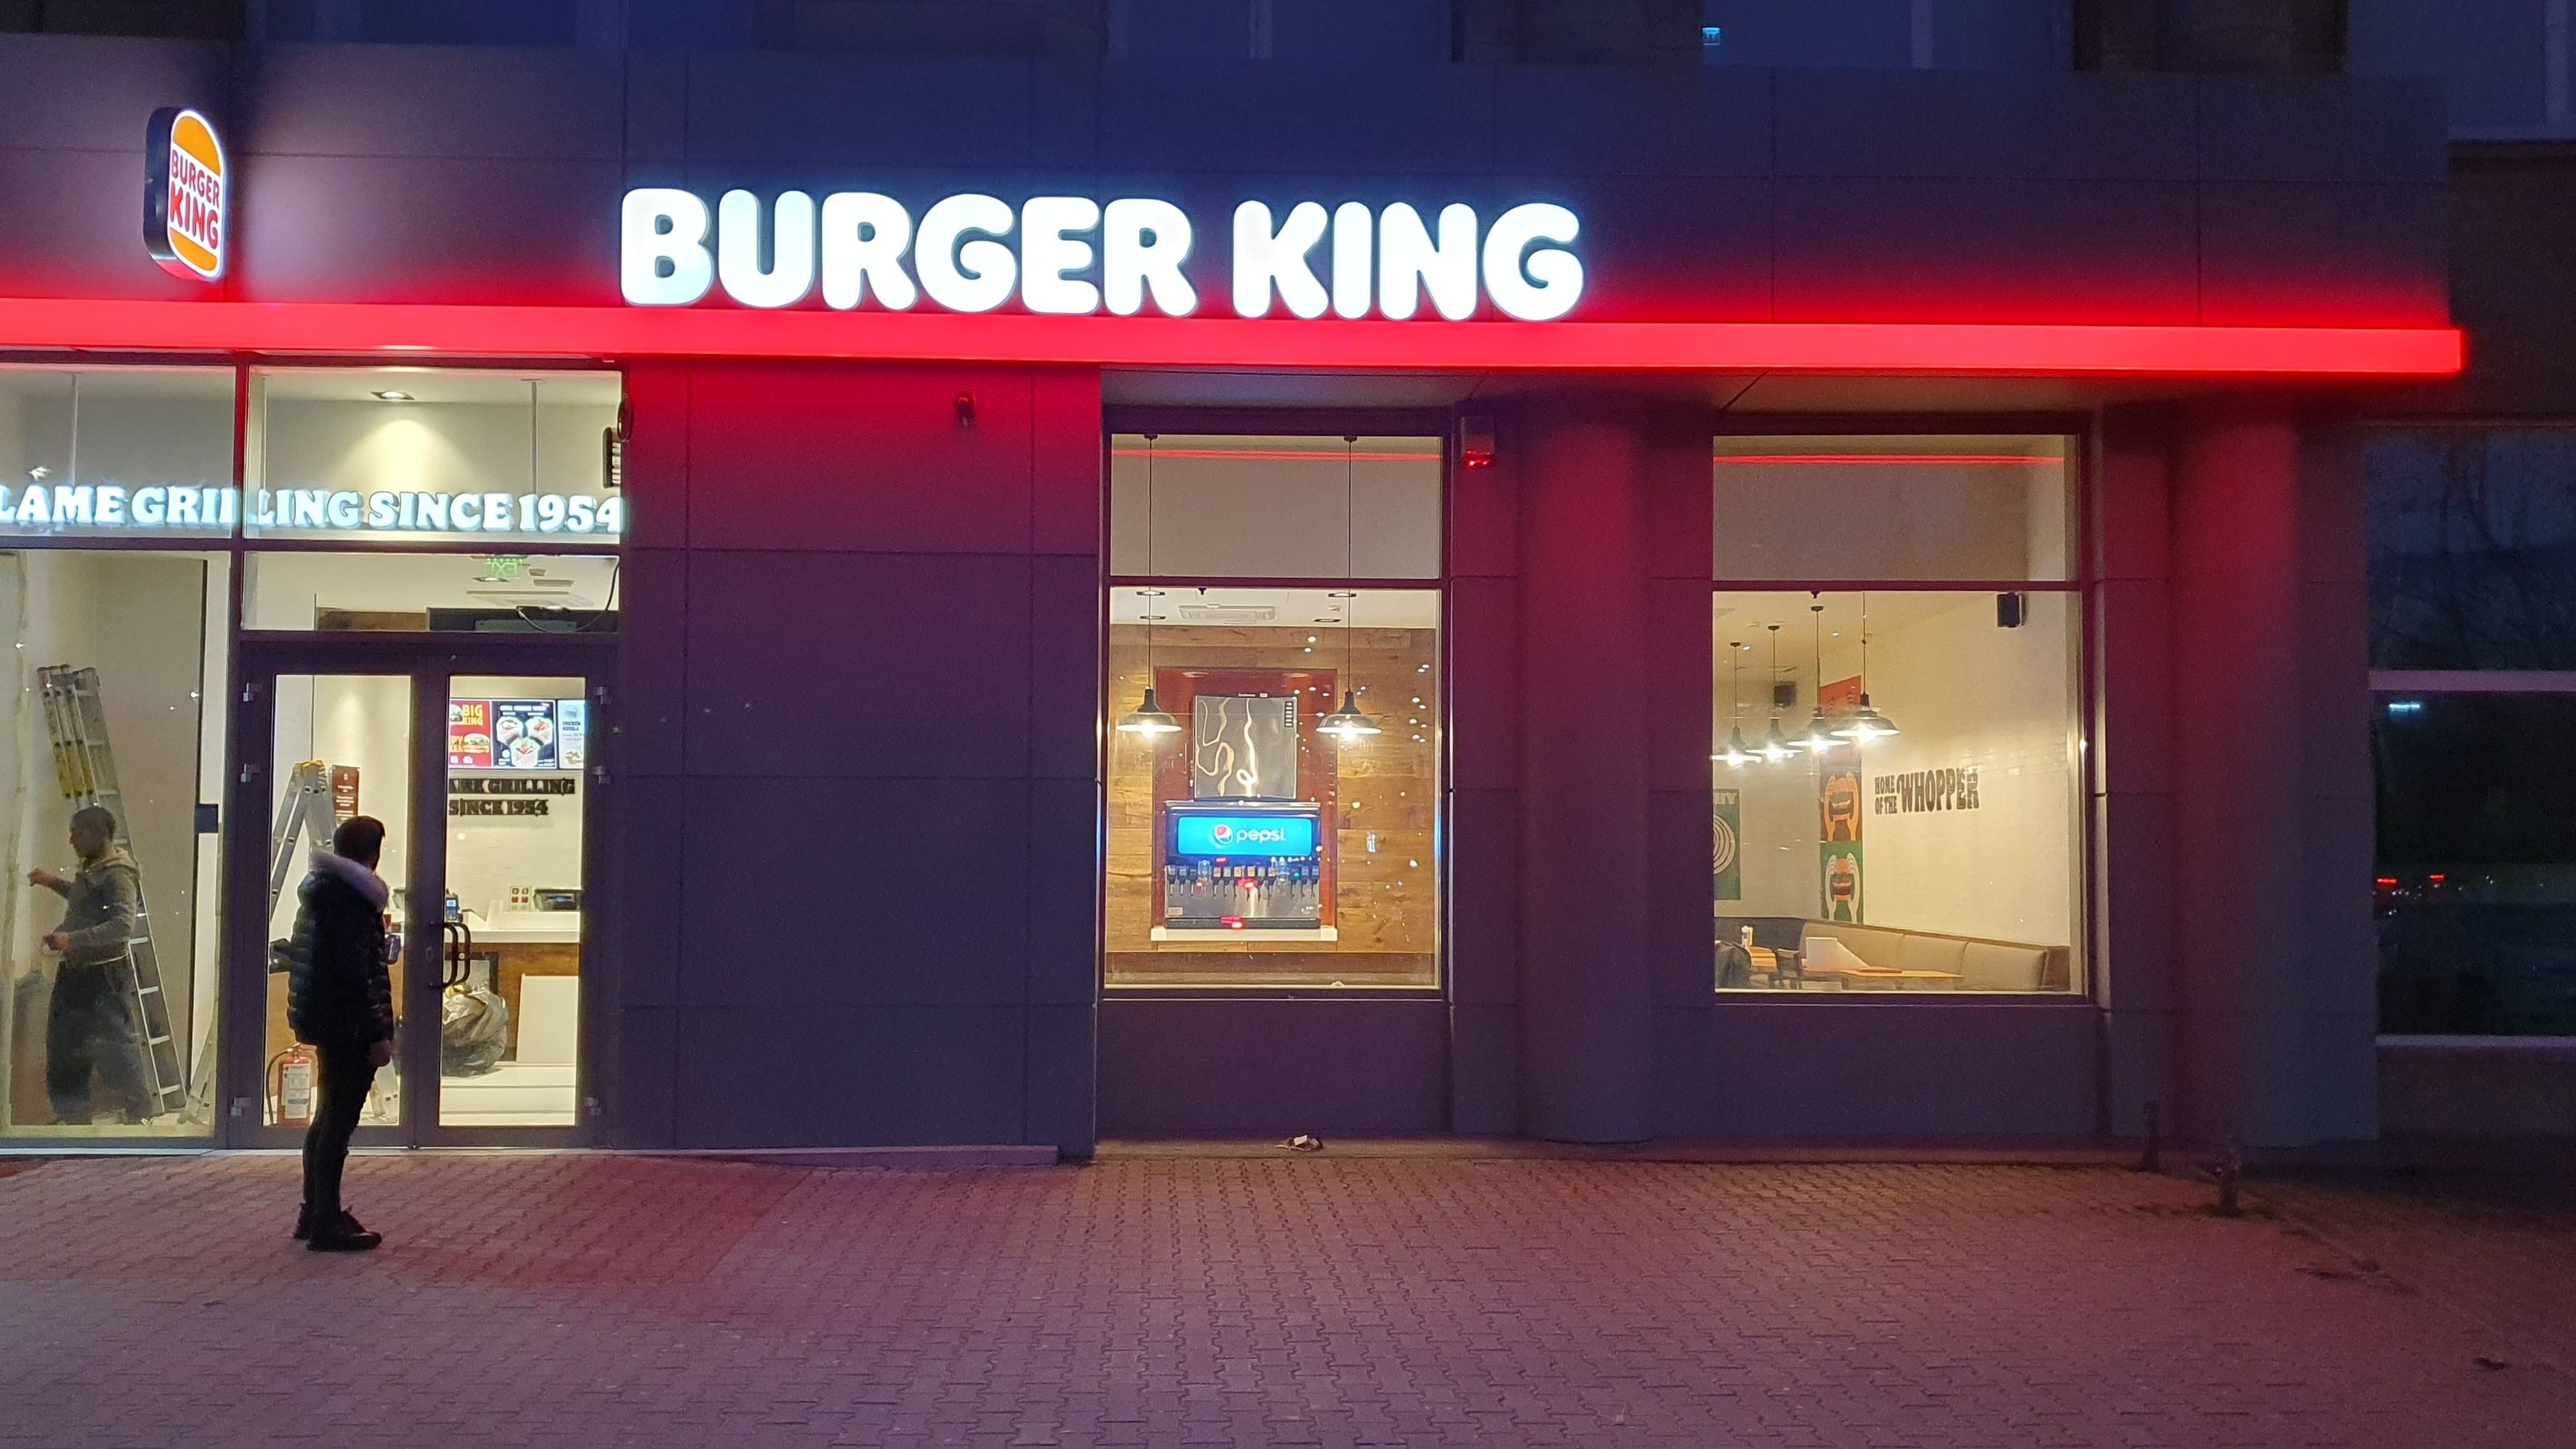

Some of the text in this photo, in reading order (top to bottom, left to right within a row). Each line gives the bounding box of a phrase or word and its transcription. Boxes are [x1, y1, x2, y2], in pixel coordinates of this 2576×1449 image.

[171, 149, 219, 209] BURGER
[170, 181, 218, 250] KING
[621, 188, 1585, 322] BURGER KING
[368, 491, 513, 531] SINCE
[519, 494, 625, 535] 1954
[462, 705, 483, 717] BIG
[462, 716, 483, 726] KING
[487, 779, 575, 794] GRILLING
[1875, 775, 1895, 795] HOME
[1897, 766, 1979, 813] WHOPPER
[449, 799, 548, 815] SINCE 1954
[1875, 796, 1898, 814] OF THE
[1236, 826, 1286, 844] pepsi
